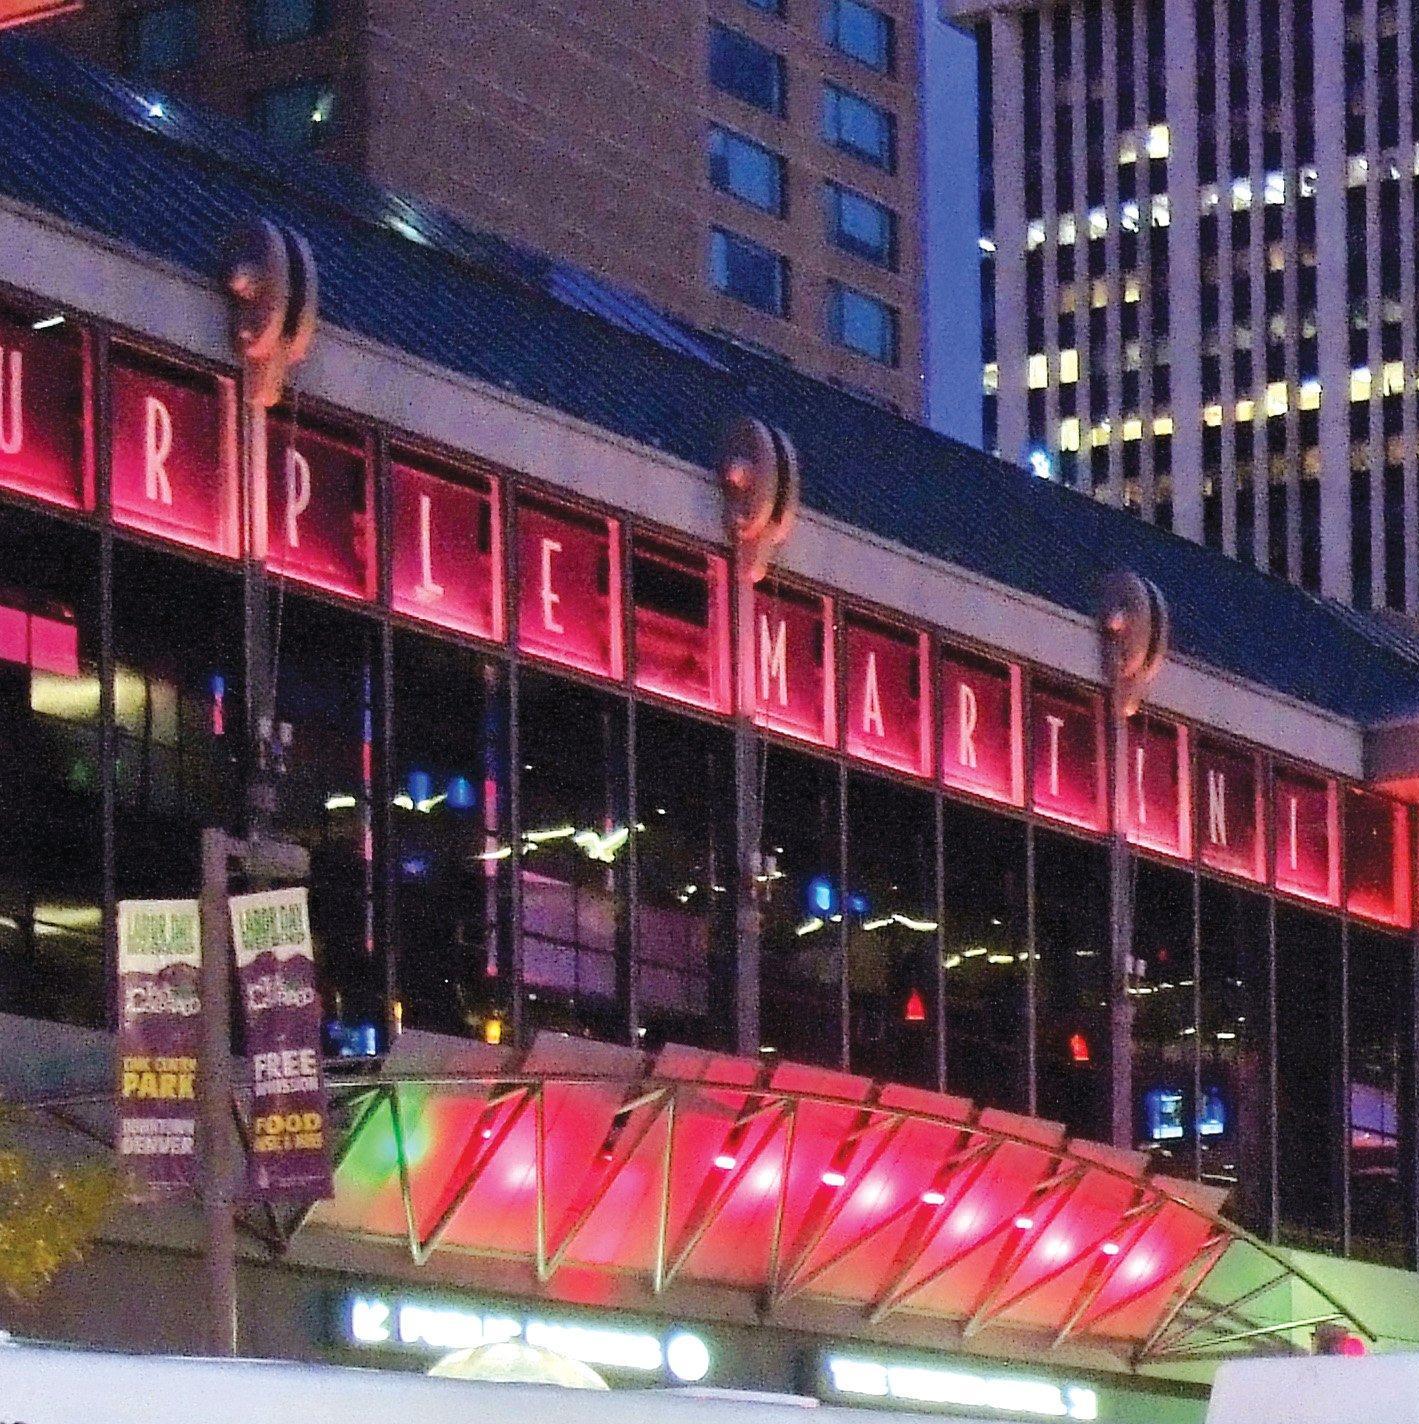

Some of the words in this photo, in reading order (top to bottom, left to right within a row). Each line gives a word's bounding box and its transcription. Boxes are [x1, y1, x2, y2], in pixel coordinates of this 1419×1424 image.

[757, 612, 1298, 870] MARTINI
[253, 1050, 319, 1081] FREE
[123, 1072, 196, 1099] PARK
[255, 1112, 323, 1135] FOOD
